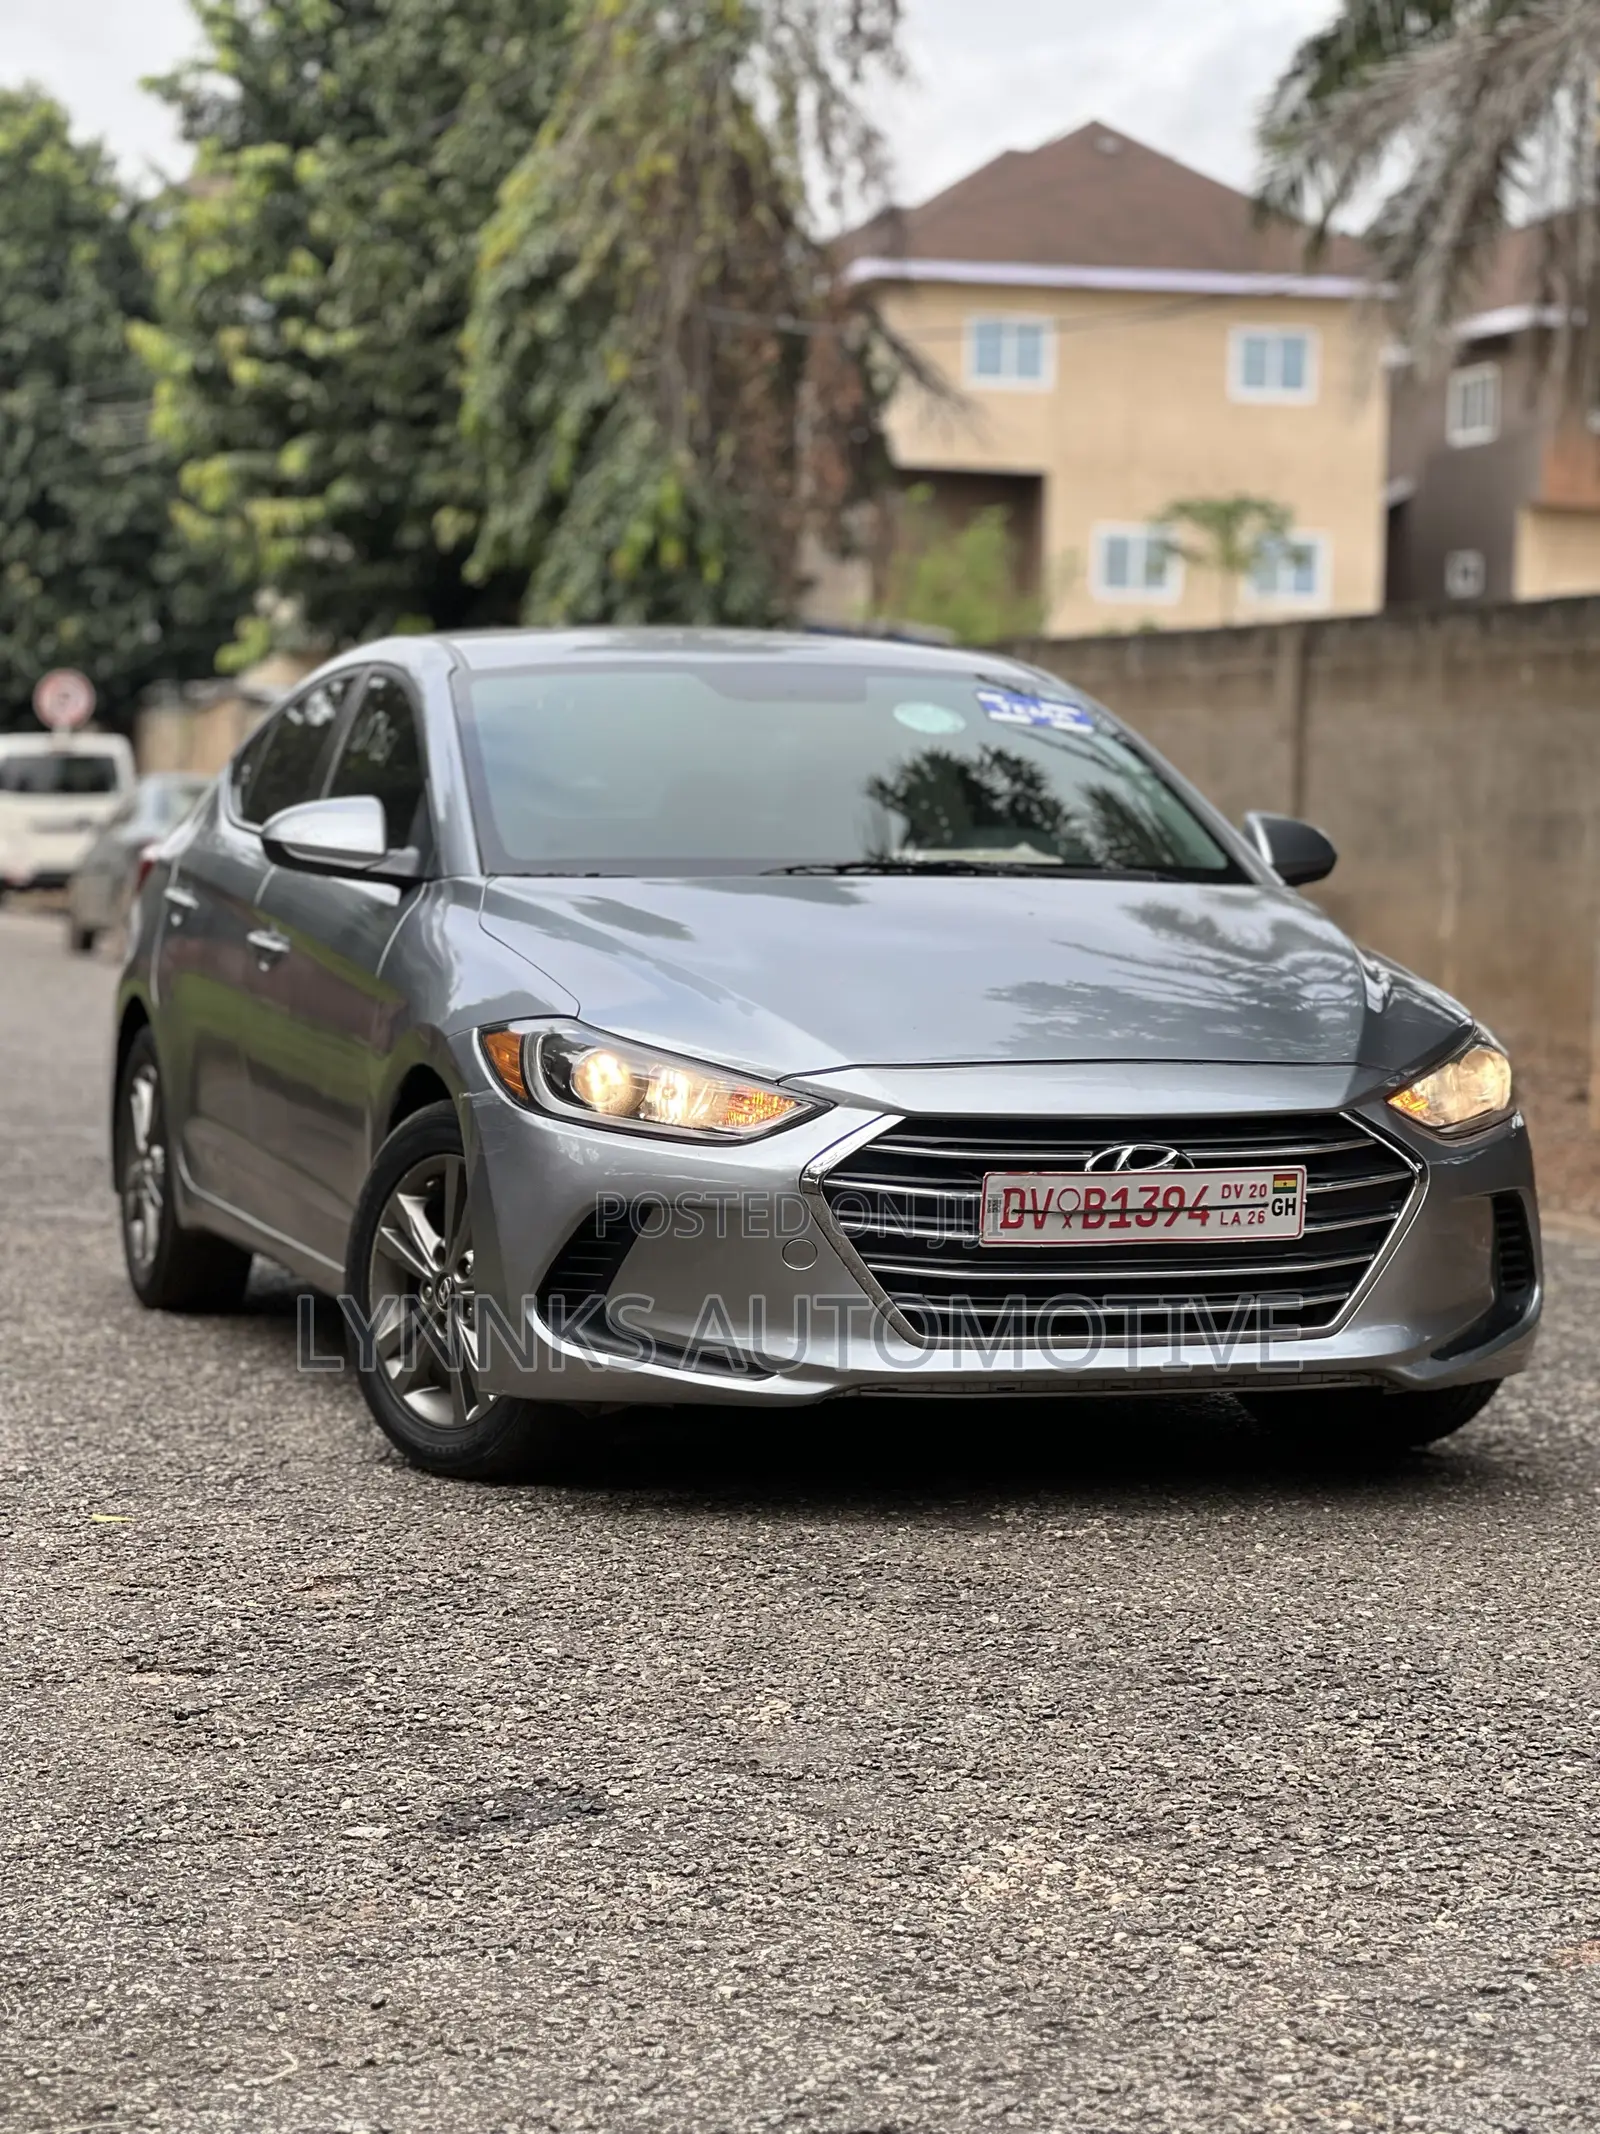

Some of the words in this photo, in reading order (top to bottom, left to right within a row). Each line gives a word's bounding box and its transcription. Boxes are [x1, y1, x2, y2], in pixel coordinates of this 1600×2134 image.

[1221, 1183, 1244, 1199] DV
[1249, 1183, 1268, 1198] 20
[1082, 1184, 1210, 1229] B1394
[1271, 1197, 1297, 1217] GH
[1220, 1211, 1241, 1225] LA
[1247, 1210, 1266, 1225] 26
